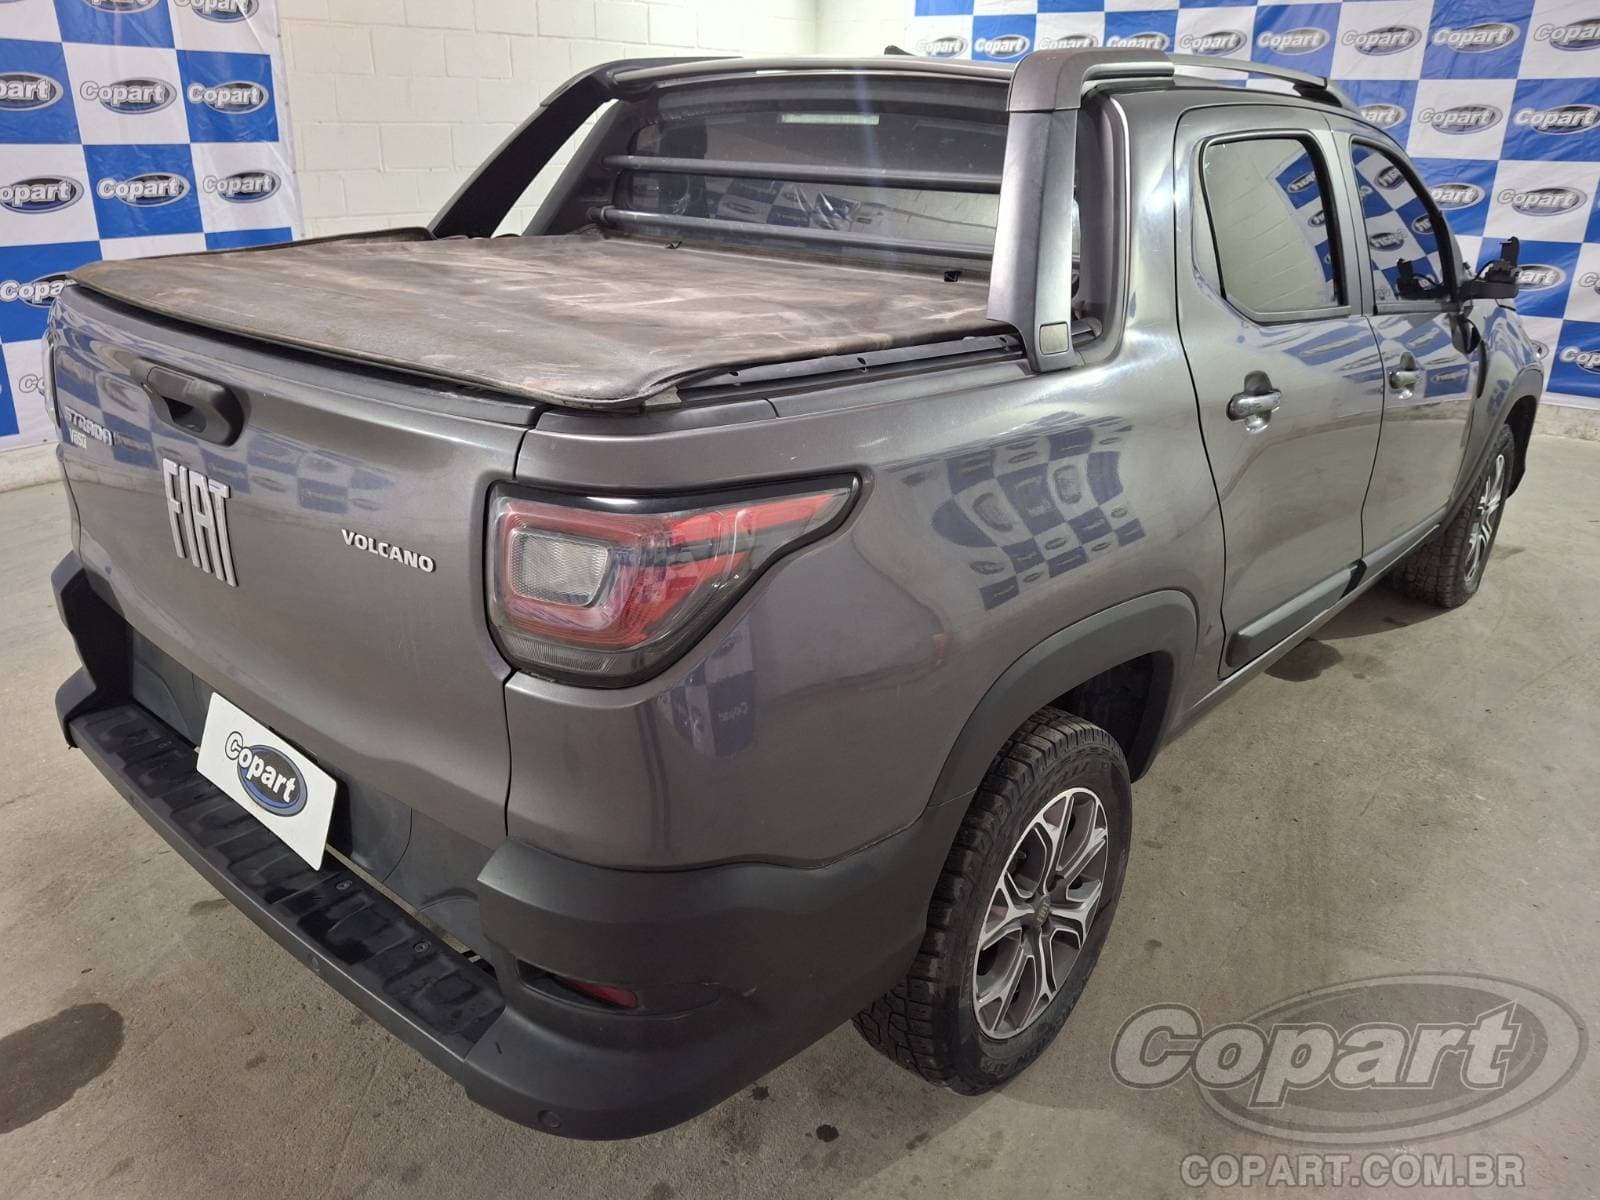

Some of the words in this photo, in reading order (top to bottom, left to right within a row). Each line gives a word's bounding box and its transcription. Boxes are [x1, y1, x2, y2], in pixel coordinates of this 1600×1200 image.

[974, 38, 1022, 54] Copart
[1179, 33, 1238, 51] Copart
[1257, 30, 1321, 50] Copart
[1341, 30, 1410, 50] Copart
[1434, 23, 1509, 47] Copart
[1534, 23, 1600, 45] Copa
[80, 80, 165, 106] Copart
[188, 83, 258, 108] Copart
[1418, 107, 1493, 132] Copart
[1513, 108, 1599, 131] Copart
[0, 180, 71, 208] opart
[97, 176, 179, 202] Copart
[203, 174, 272, 198] Copart
[1431, 188, 1475, 204] part
[1498, 189, 1577, 210] Copart
[0, 279, 77, 304] Copa
[1560, 345, 1600, 369] Cop
[163, 458, 238, 588] FIAT
[341, 528, 435, 574] VOLCANO
[225, 730, 296, 803] Copart
